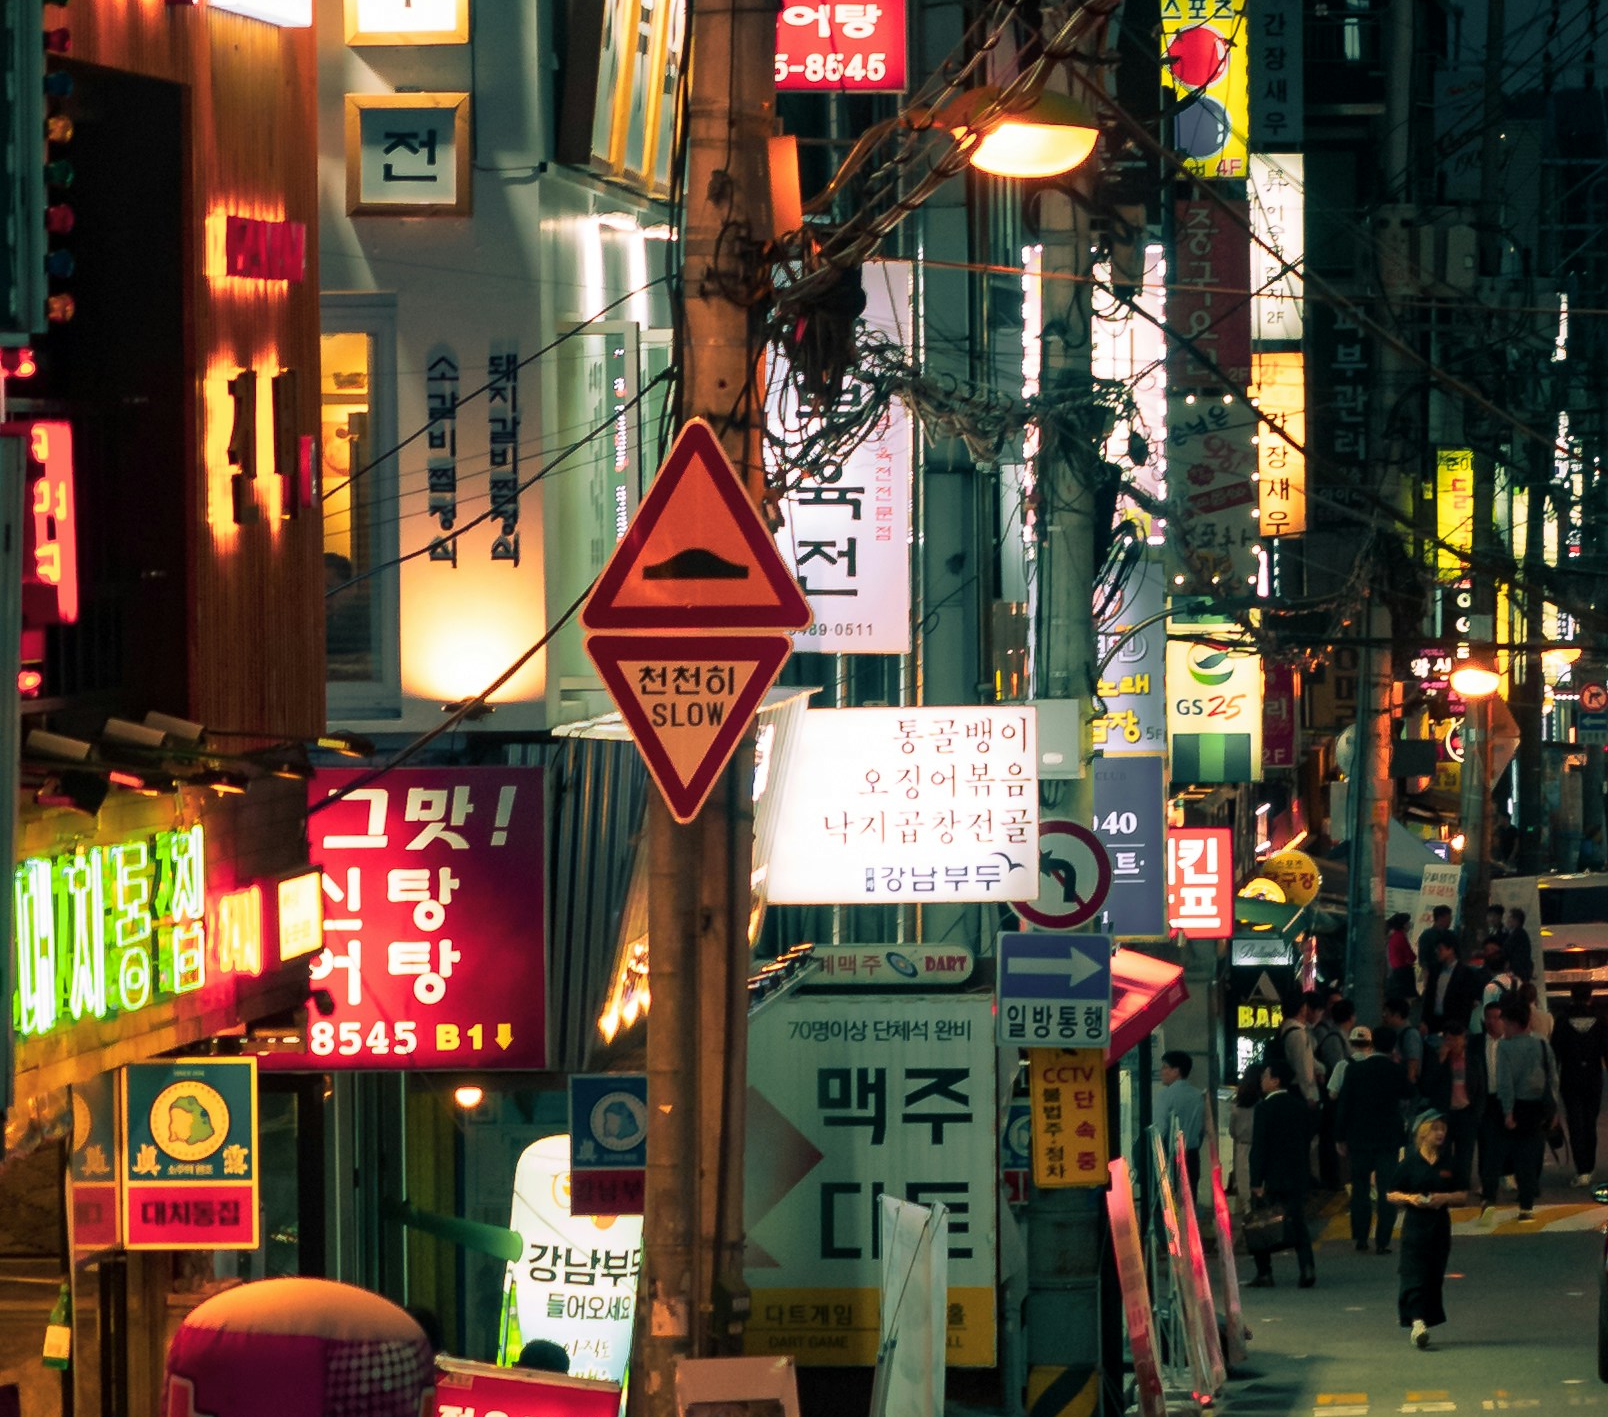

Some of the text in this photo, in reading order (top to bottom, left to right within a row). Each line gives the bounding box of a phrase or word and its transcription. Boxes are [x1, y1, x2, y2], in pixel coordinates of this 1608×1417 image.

[781, 3, 883, 39] 어탕
[1262, 11, 1289, 137] 간장새우
[382, 128, 438, 183] 전
[1215, 157, 1243, 176] 4F
[1266, 311, 1285, 325] 2F
[637, 663, 736, 697] 천천히
[651, 702, 726, 729] SLOW
[893, 716, 1028, 755] 통골뱅이
[858, 762, 1032, 800] 오징어볶음
[823, 808, 1033, 846] 낙지곱창전골
[880, 865, 1001, 893] 강남부두
[924, 955, 968, 974] DART
[310, 1020, 484, 1056] 8545 B1
[787, 1020, 972, 1043] 70명이상 단체석 완비
[1007, 1004, 1104, 1040] 일방통행
[1042, 1066, 1096, 1085] CCTV
[818, 1067, 973, 1146] 맥주
[1073, 1090, 1098, 1173] 단속중
[765, 1304, 853, 1327] 다트게임
[768, 1337, 849, 1350] DART GAME
